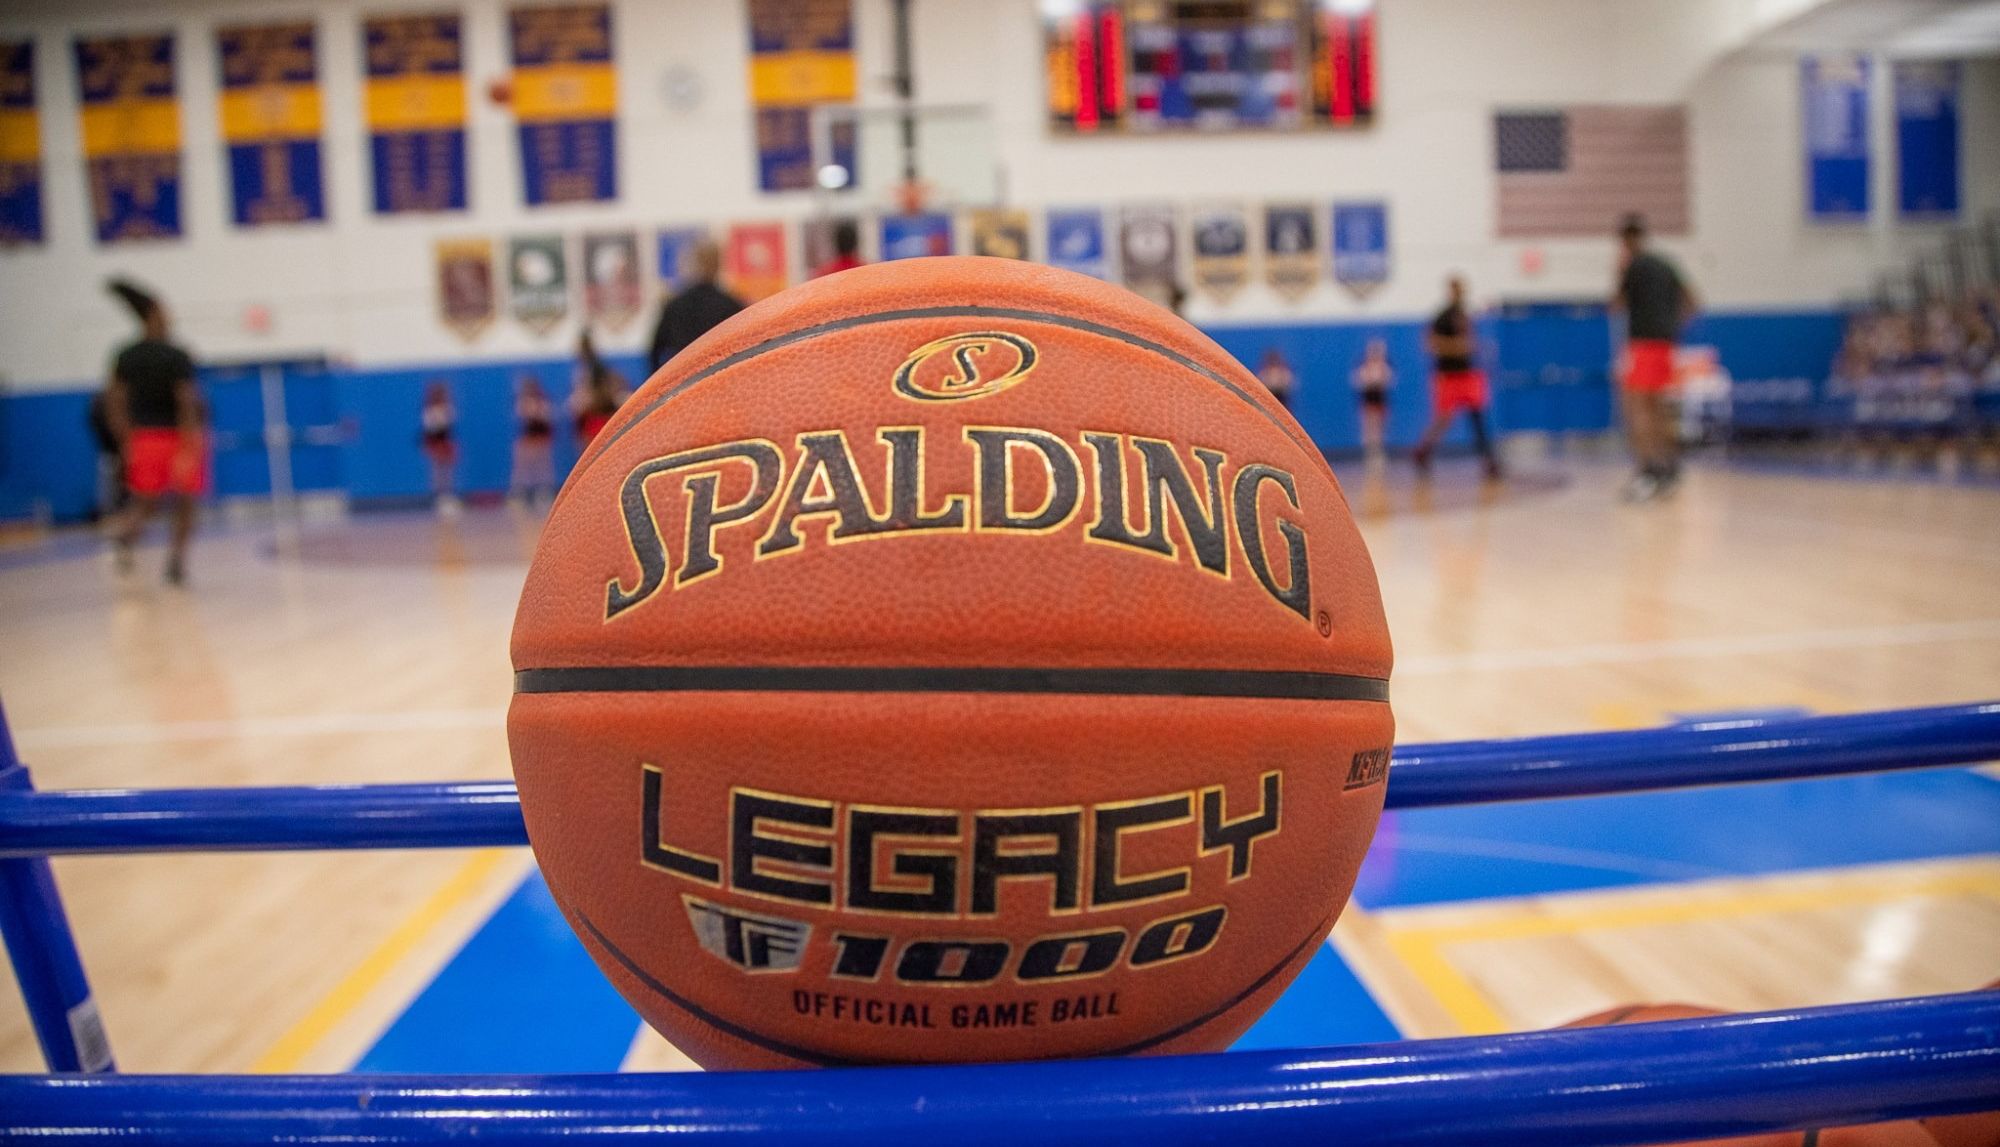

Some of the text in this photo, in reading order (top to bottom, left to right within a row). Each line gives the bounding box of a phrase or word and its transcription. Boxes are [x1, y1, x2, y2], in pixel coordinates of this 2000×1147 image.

[604, 425, 1312, 625] SPALDING
[640, 762, 1283, 921] LEGACY
[686, 899, 1229, 986] TF 1000
[792, 988, 1120, 1030] OFFICIAL GAME BALL
